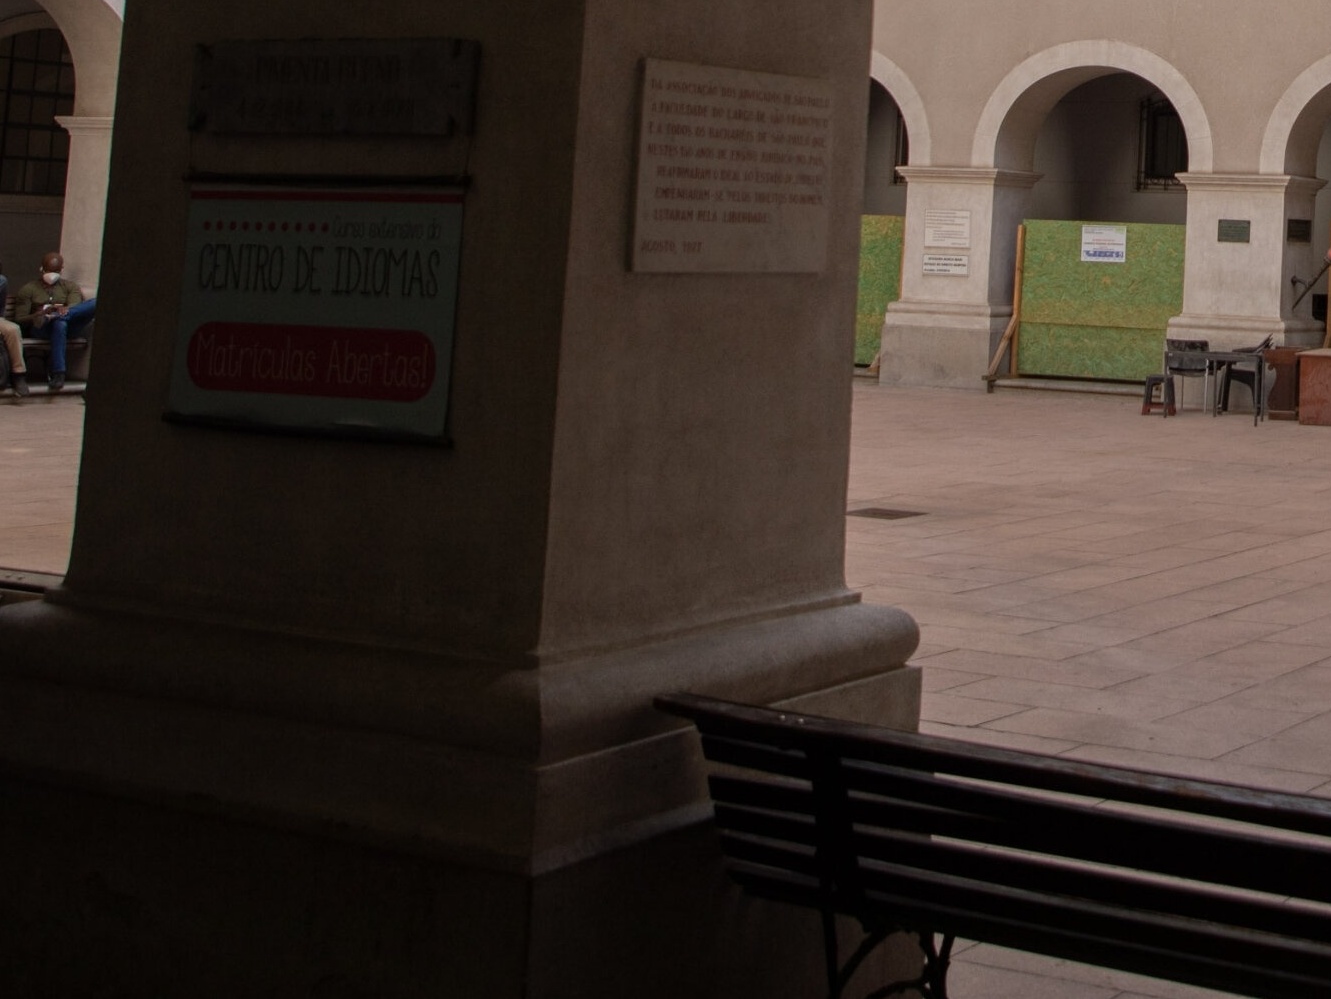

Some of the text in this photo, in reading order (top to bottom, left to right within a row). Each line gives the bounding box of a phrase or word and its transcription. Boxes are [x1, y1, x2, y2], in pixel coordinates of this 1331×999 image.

[198, 243, 441, 298] CENTRO DE IDIOMAS
[325, 339, 429, 389] Abertas!
